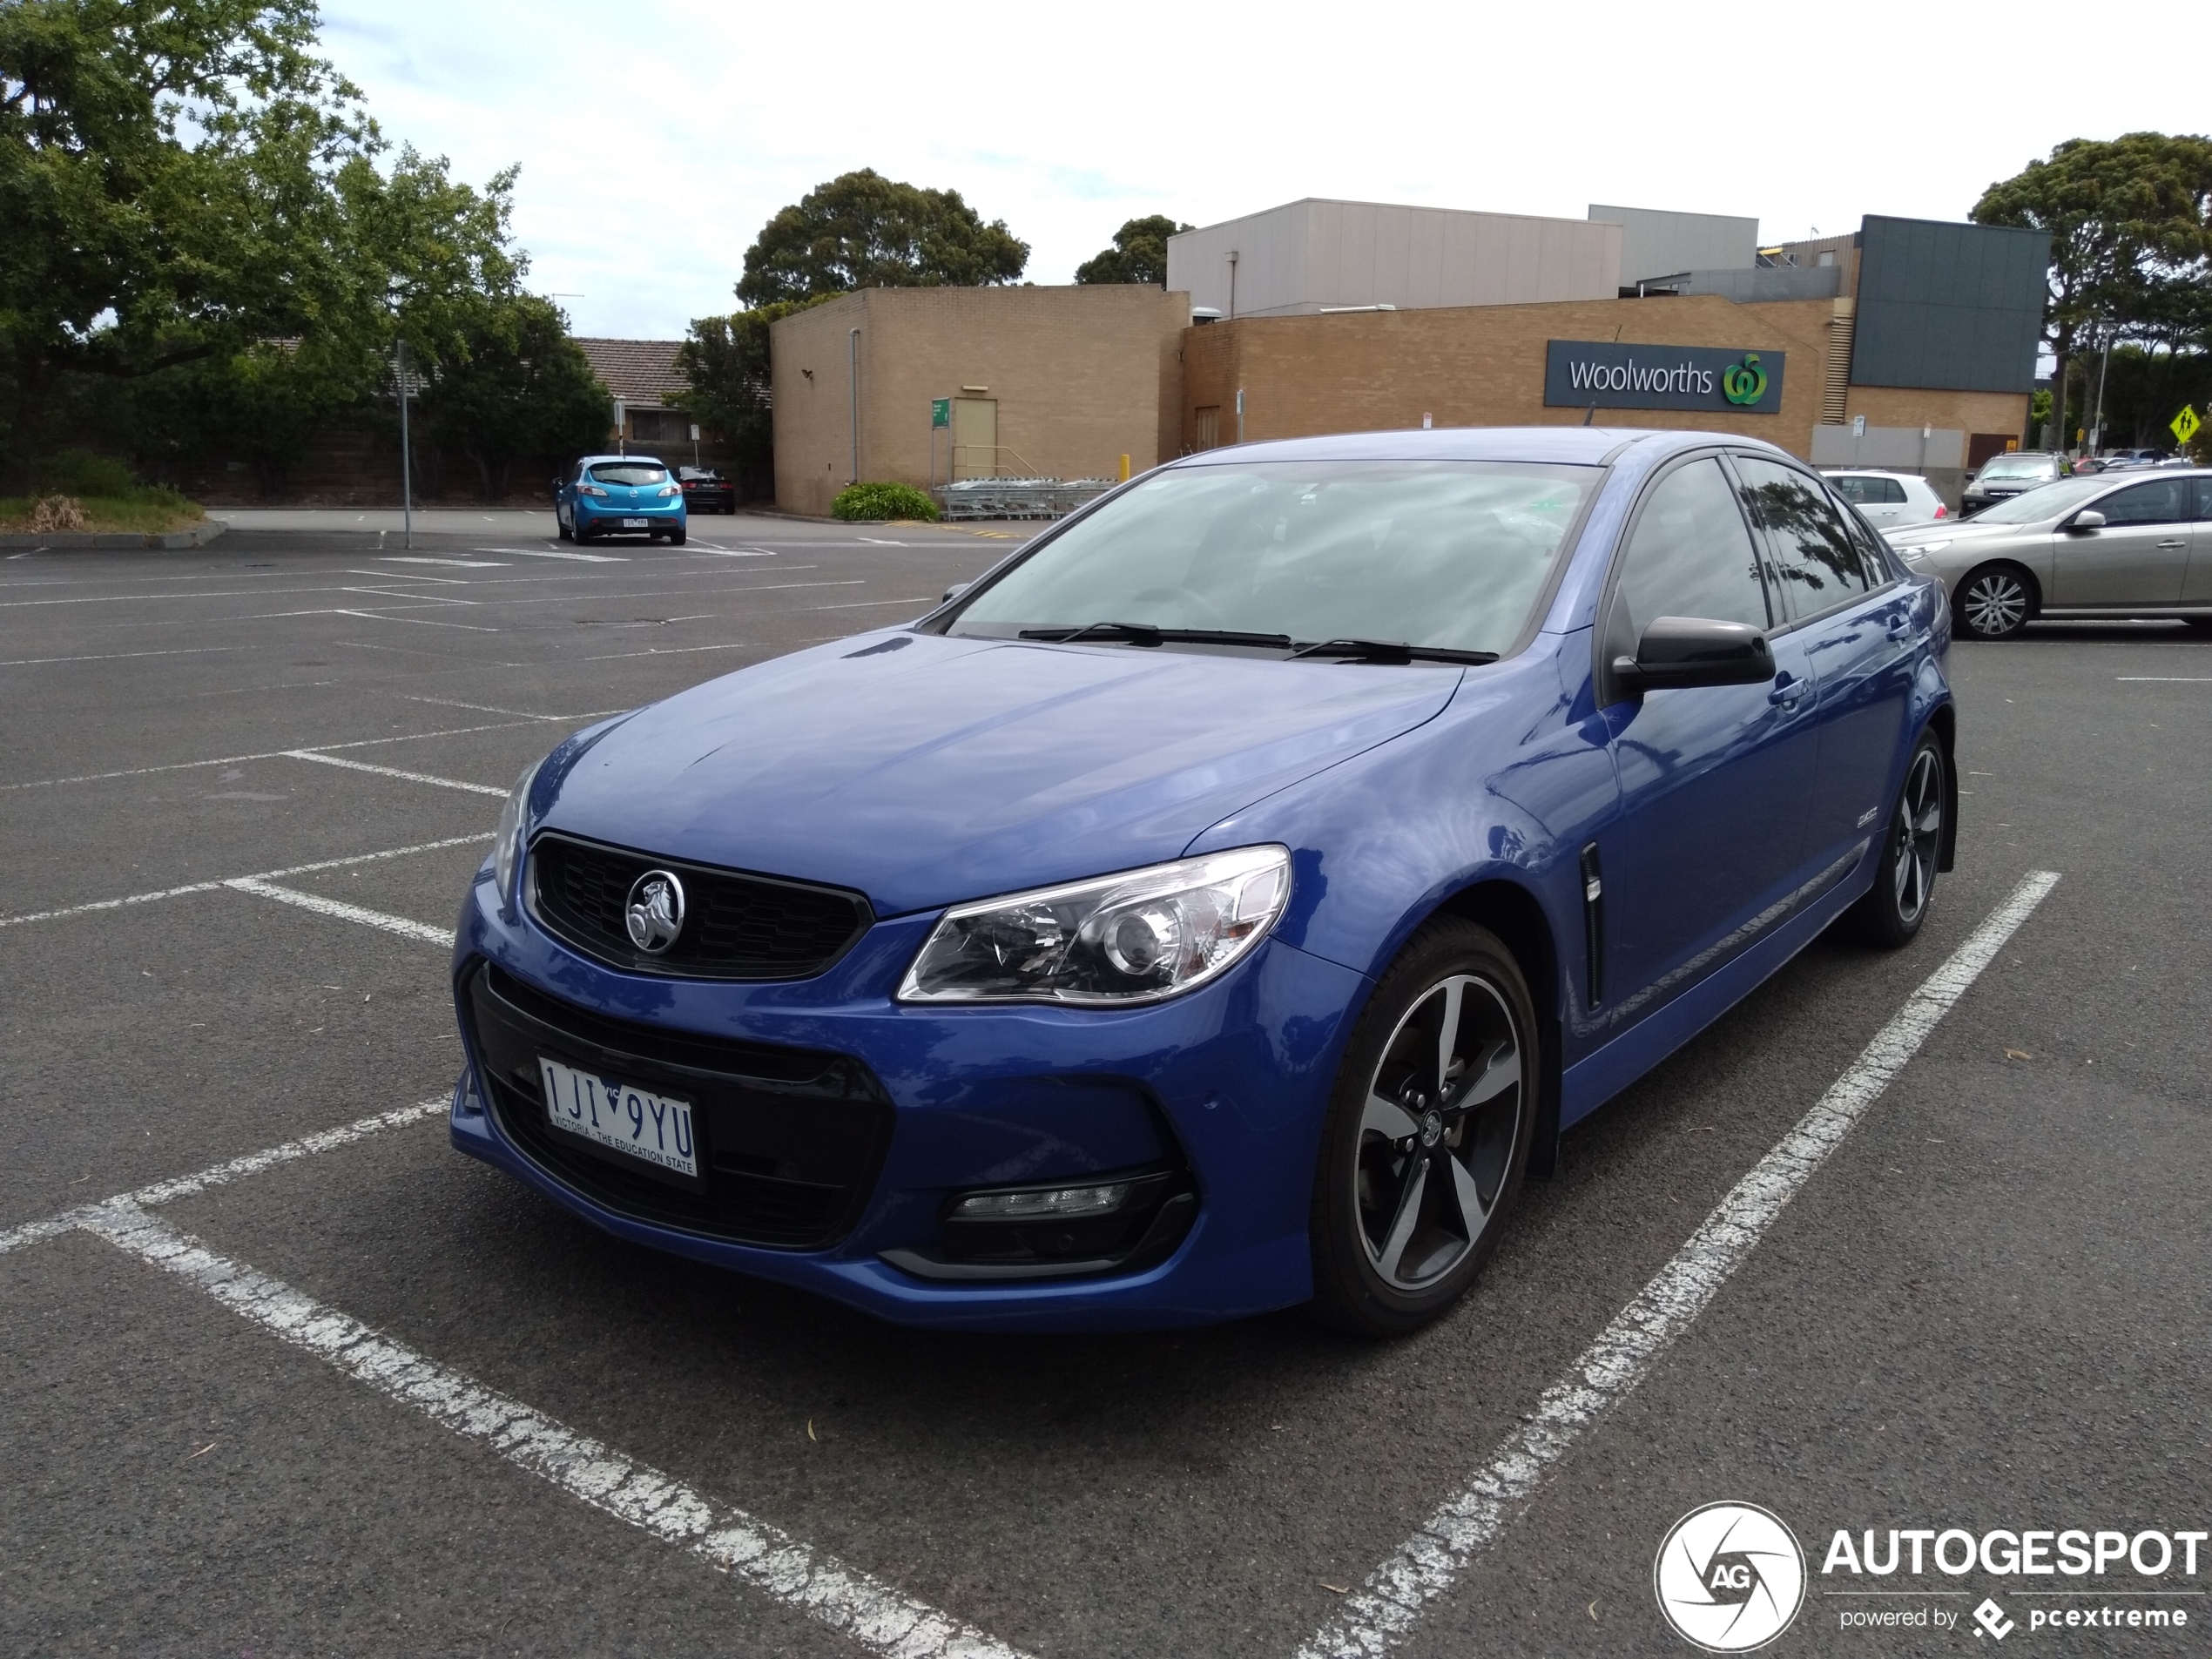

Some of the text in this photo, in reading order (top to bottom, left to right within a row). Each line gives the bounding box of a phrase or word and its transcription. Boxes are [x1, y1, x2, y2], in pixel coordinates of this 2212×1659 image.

[1569, 359, 1713, 395] Woolworths
[547, 1066, 692, 1158] 1JI 9YU
[605, 1087, 620, 1099] VIC
[554, 1115, 590, 1136] VICTORIA
[597, 1132, 614, 1146] THE
[615, 1138, 664, 1163] EDUCATION
[665, 1156, 693, 1173] STATE
